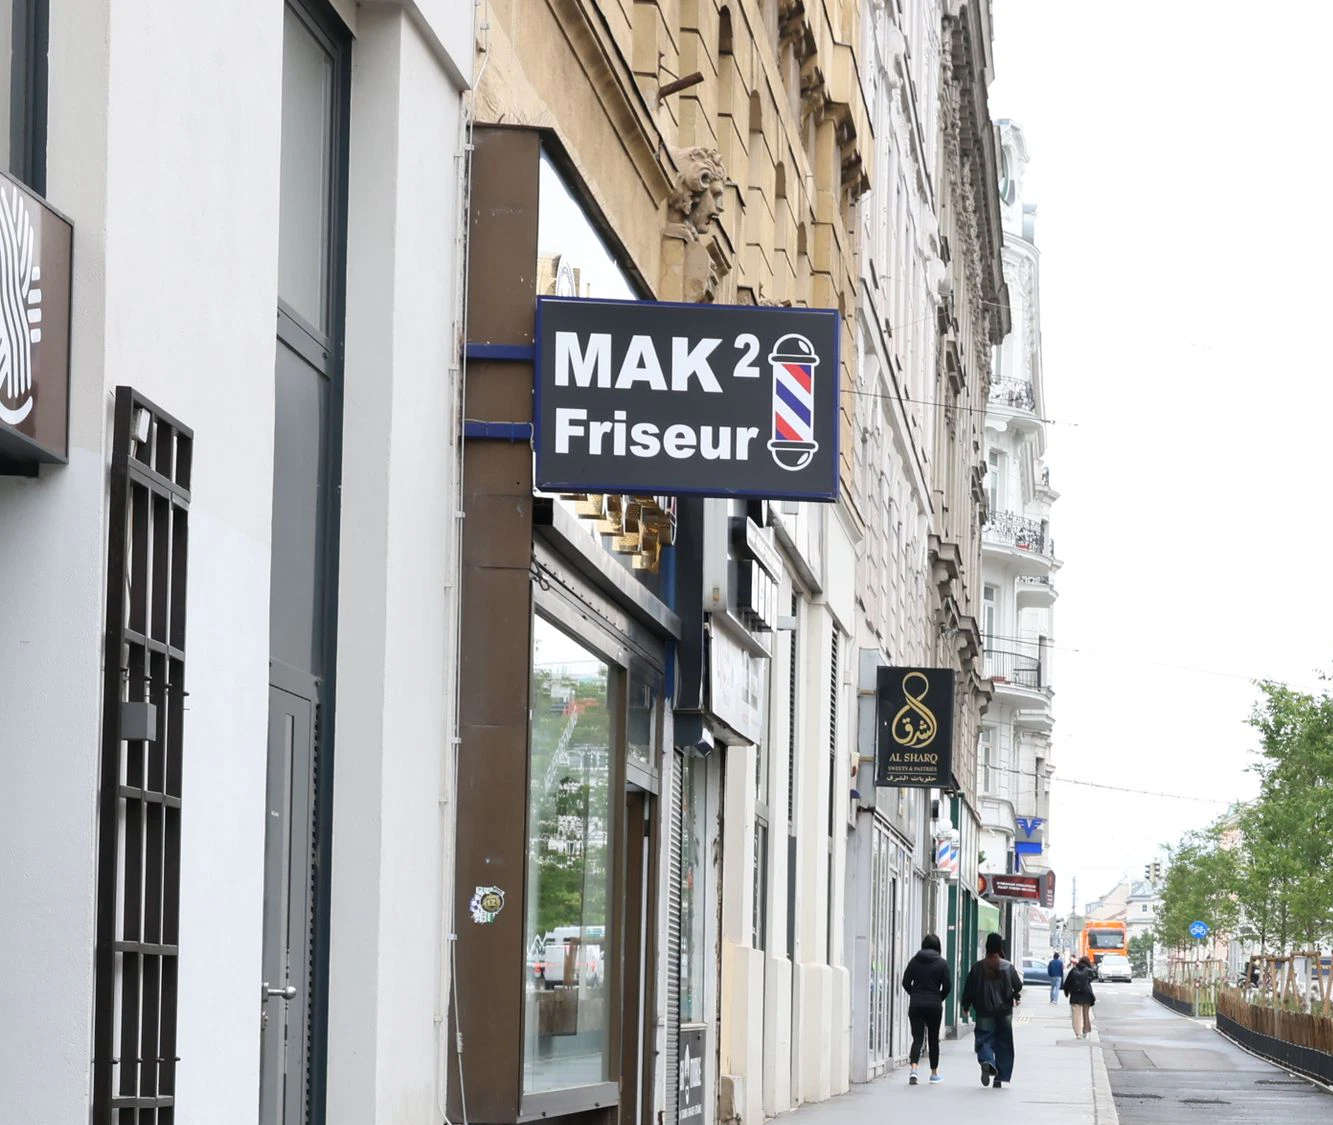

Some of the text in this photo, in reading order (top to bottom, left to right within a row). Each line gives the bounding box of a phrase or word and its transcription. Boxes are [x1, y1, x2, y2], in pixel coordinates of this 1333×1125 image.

[555, 331, 724, 394] MAK
[555, 408, 760, 461] Friseur
[889, 753, 938, 764] AL SHARQ
